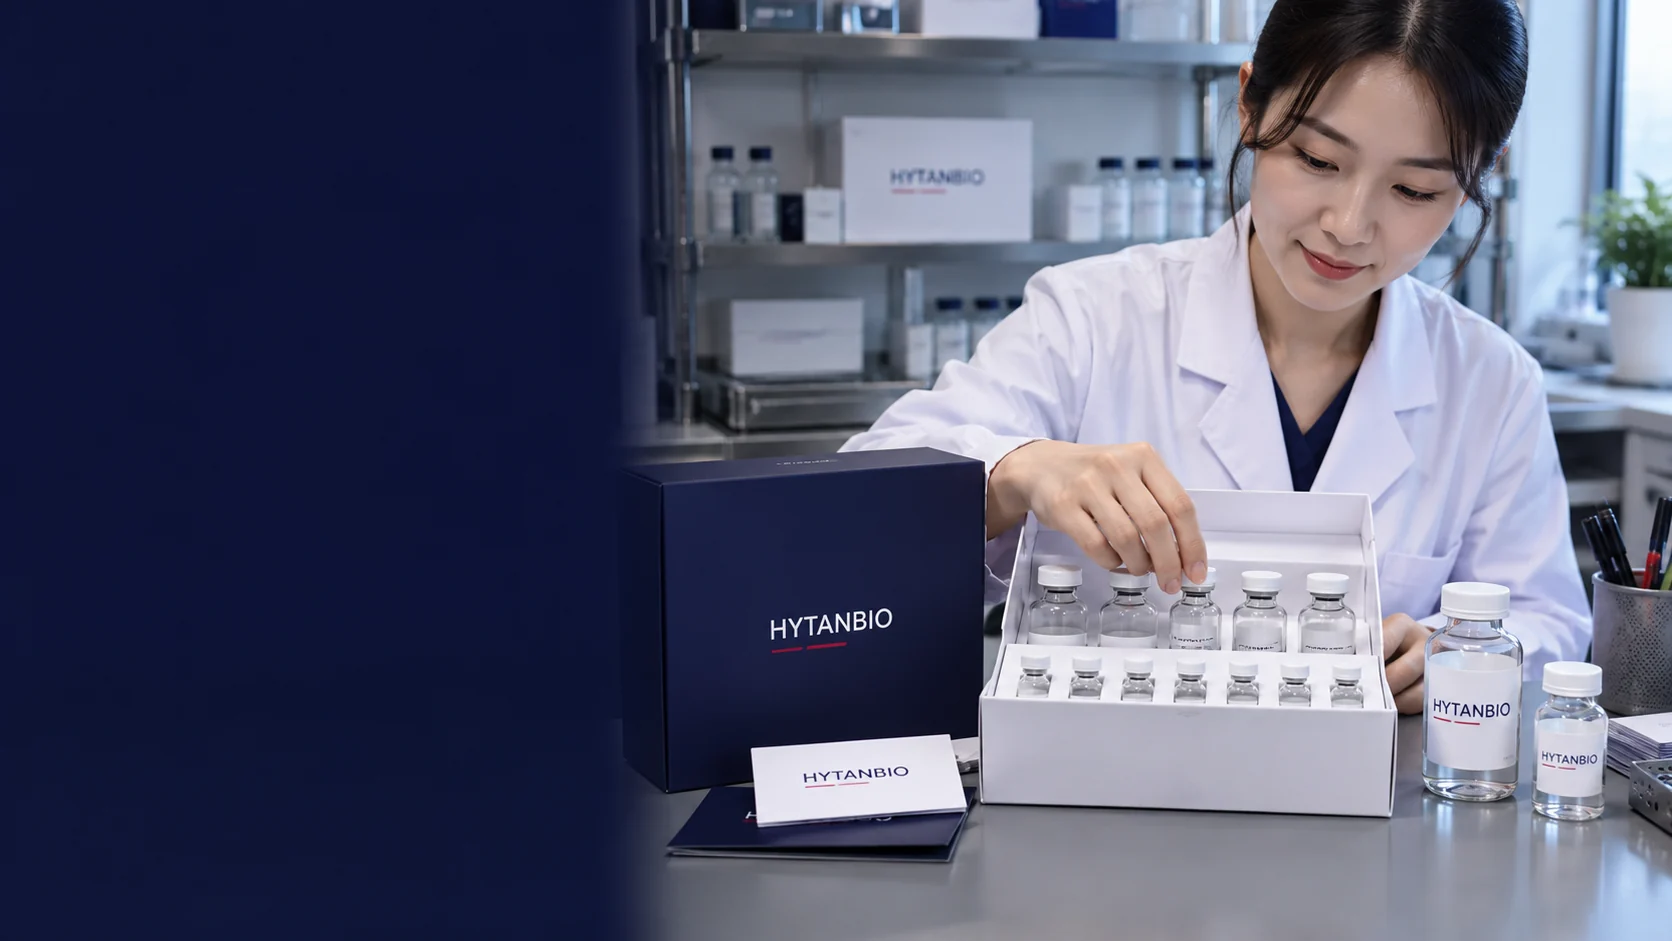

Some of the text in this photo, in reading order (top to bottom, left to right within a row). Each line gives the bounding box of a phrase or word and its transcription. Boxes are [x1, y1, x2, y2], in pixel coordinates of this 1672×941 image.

[890, 168, 985, 186] HYTANBIO
[770, 608, 893, 640] HYTANBIO
[1433, 698, 1511, 718] HYTANBIO
[1542, 750, 1598, 765] HYTANBIO
[803, 766, 909, 782] HYTANBIO
